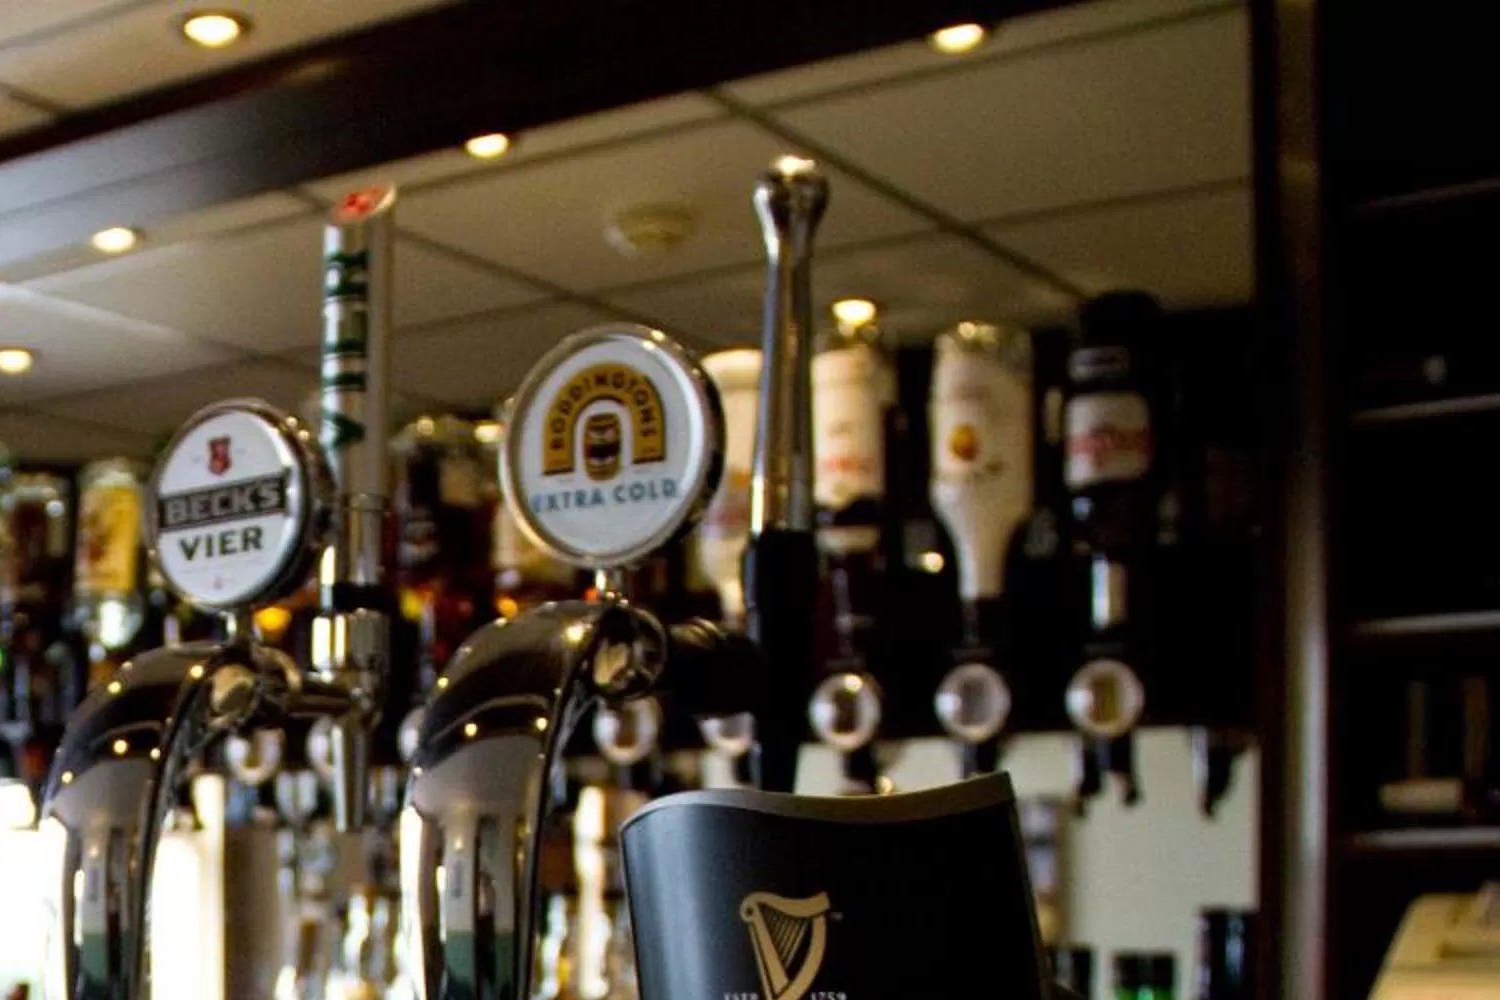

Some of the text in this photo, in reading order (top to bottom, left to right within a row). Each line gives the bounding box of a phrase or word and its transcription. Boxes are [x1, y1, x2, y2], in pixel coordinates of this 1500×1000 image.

[531, 478, 678, 513] EXTRA COLD
[179, 525, 263, 561] VIER
